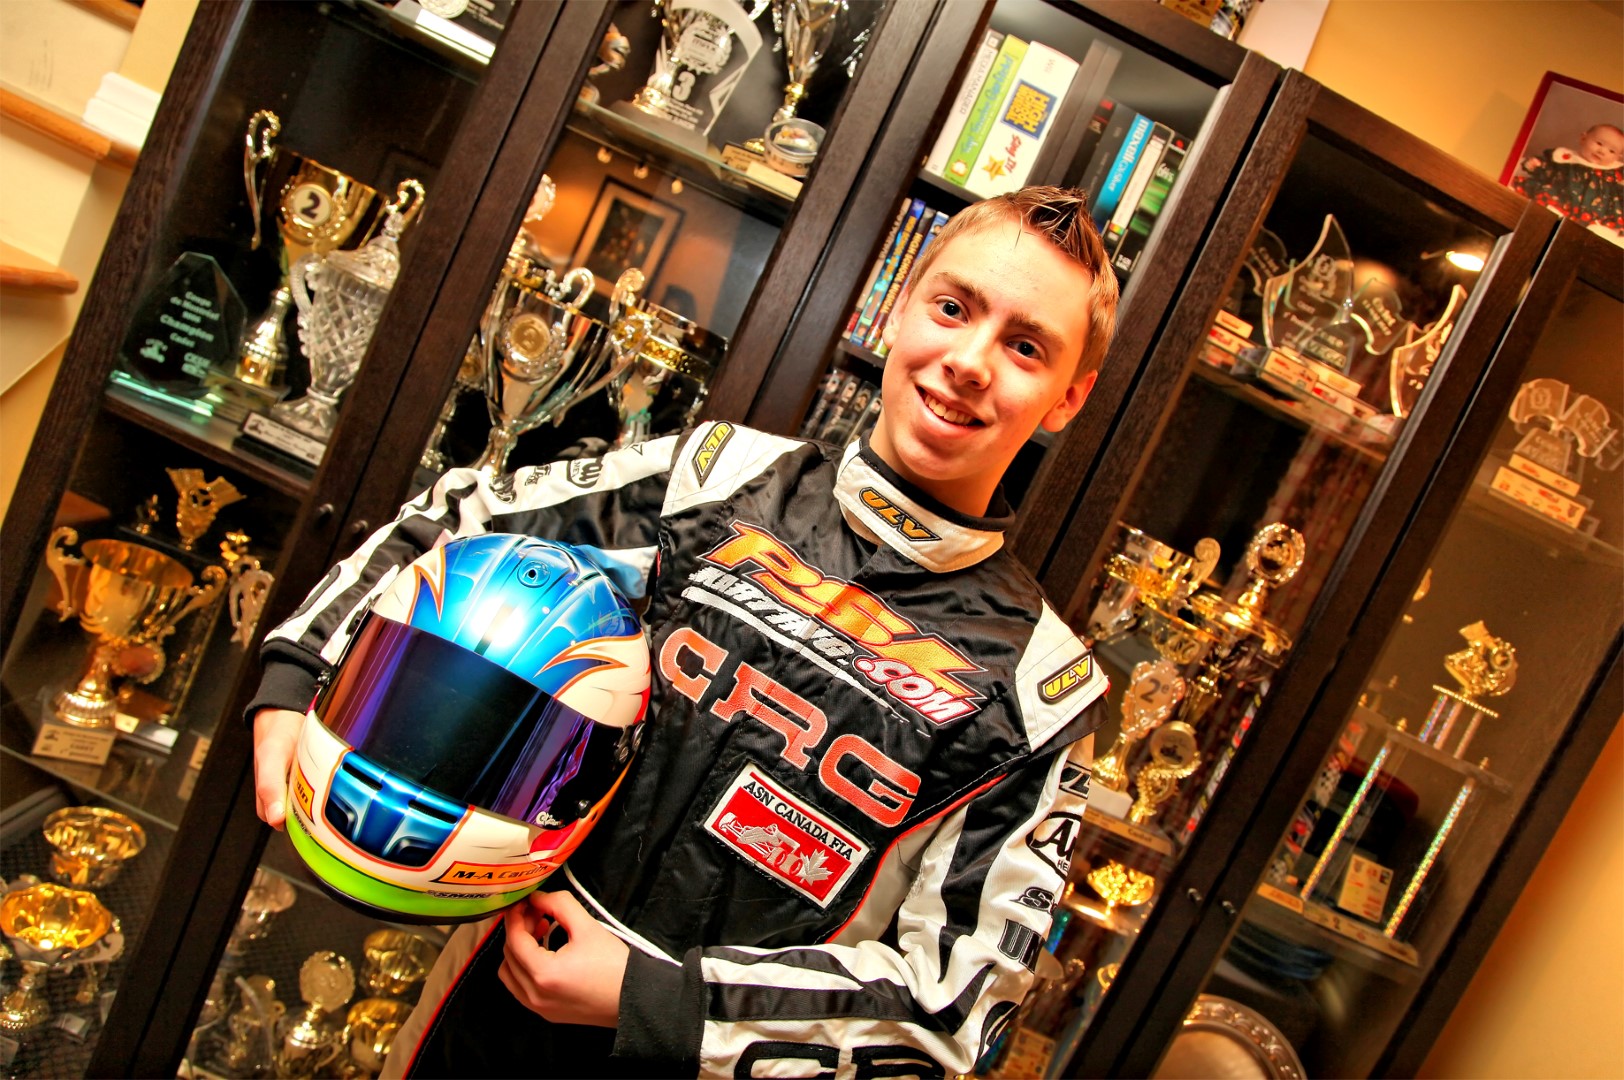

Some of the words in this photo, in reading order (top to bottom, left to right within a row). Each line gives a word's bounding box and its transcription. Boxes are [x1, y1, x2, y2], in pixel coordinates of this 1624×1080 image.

[672, 71, 696, 101] 3
[1004, 83, 1031, 123] MUSICAL
[1013, 87, 1039, 127] SCHOOL
[1022, 92, 1051, 133] HIGH
[1121, 118, 1151, 162] maxell
[302, 195, 322, 219] 2
[906, 231, 924, 255] HIGH
[892, 252, 914, 284] SCHOOL
[878, 281, 900, 315] MUSICAL
[160, 314, 214, 342] Champion
[863, 489, 933, 538] ULV
[1043, 657, 1091, 698] ULV
[659, 627, 922, 829] CRG
[743, 780, 776, 808] ASN
[774, 802, 830, 845] CANADA
[828, 836, 855, 861] FIA
[452, 869, 494, 881] M-A
